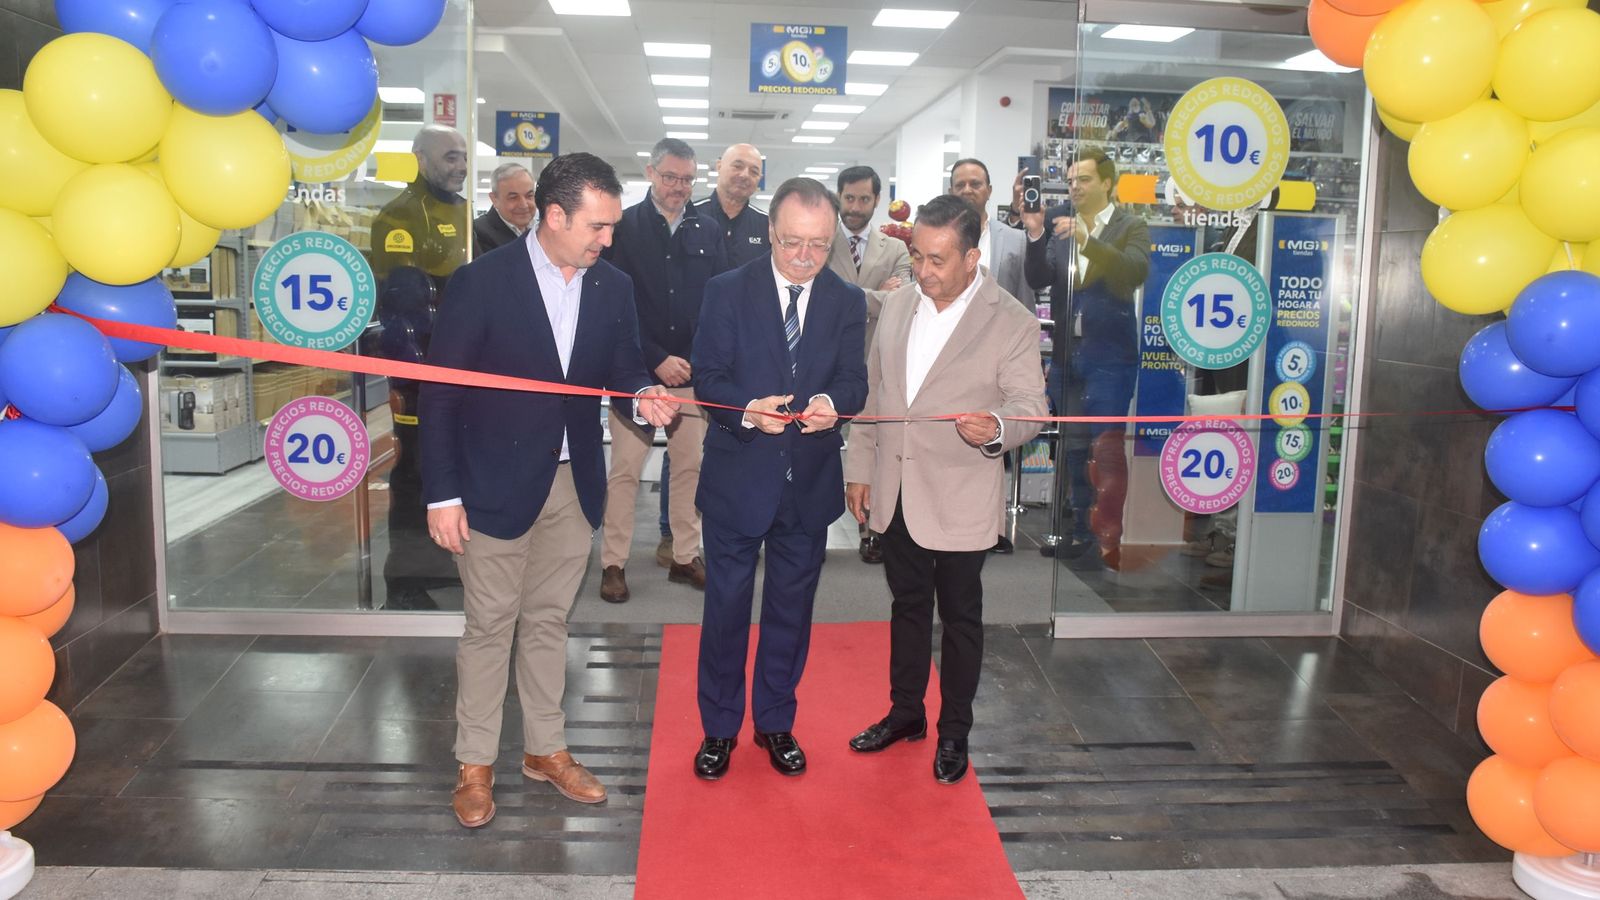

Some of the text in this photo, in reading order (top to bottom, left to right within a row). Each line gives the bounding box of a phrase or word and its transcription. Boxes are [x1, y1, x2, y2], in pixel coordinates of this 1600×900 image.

[758, 85, 838, 95] PRECIOS REDONDOS
[1060, 102, 1111, 114] CONQUISTAR
[1058, 114, 1108, 128] EL MUNDO
[1172, 83, 1284, 146] PRECIOS REDONDOS
[1195, 124, 1261, 165] 10€
[1172, 146, 1214, 201] PRECIOS
[1216, 152, 1283, 205] REDONDOS
[1183, 209, 1251, 227] tiendas
[259, 237, 369, 292] PRECIOS REDONDOS
[1280, 276, 1322, 289] TODO
[281, 274, 348, 311] 15€
[1168, 258, 1266, 310] PRECIOS REDONDOS
[1278, 290, 1322, 300] PARA TU
[1187, 293, 1247, 328] 15€
[1277, 310, 1320, 320] PRECIOS
[1278, 300, 1320, 309] HOGAR A
[259, 297, 369, 349] PRECIOS REDONDOS
[1167, 315, 1204, 361] PRECIOS
[1207, 315, 1265, 364] REDONDOS
[1276, 319, 1319, 328] REDONDOS
[270, 401, 365, 449] PRECIOS REDONDOS
[1166, 421, 1202, 462] PRECIOS
[1205, 420, 1251, 464] REDONDOS
[287, 432, 346, 465] 20€
[1181, 448, 1233, 479] 20€
[271, 451, 365, 496] PRECIOS REDONDOS
[1165, 466, 1197, 507] PRECIOS
[1198, 468, 1250, 510] REDONDOS
